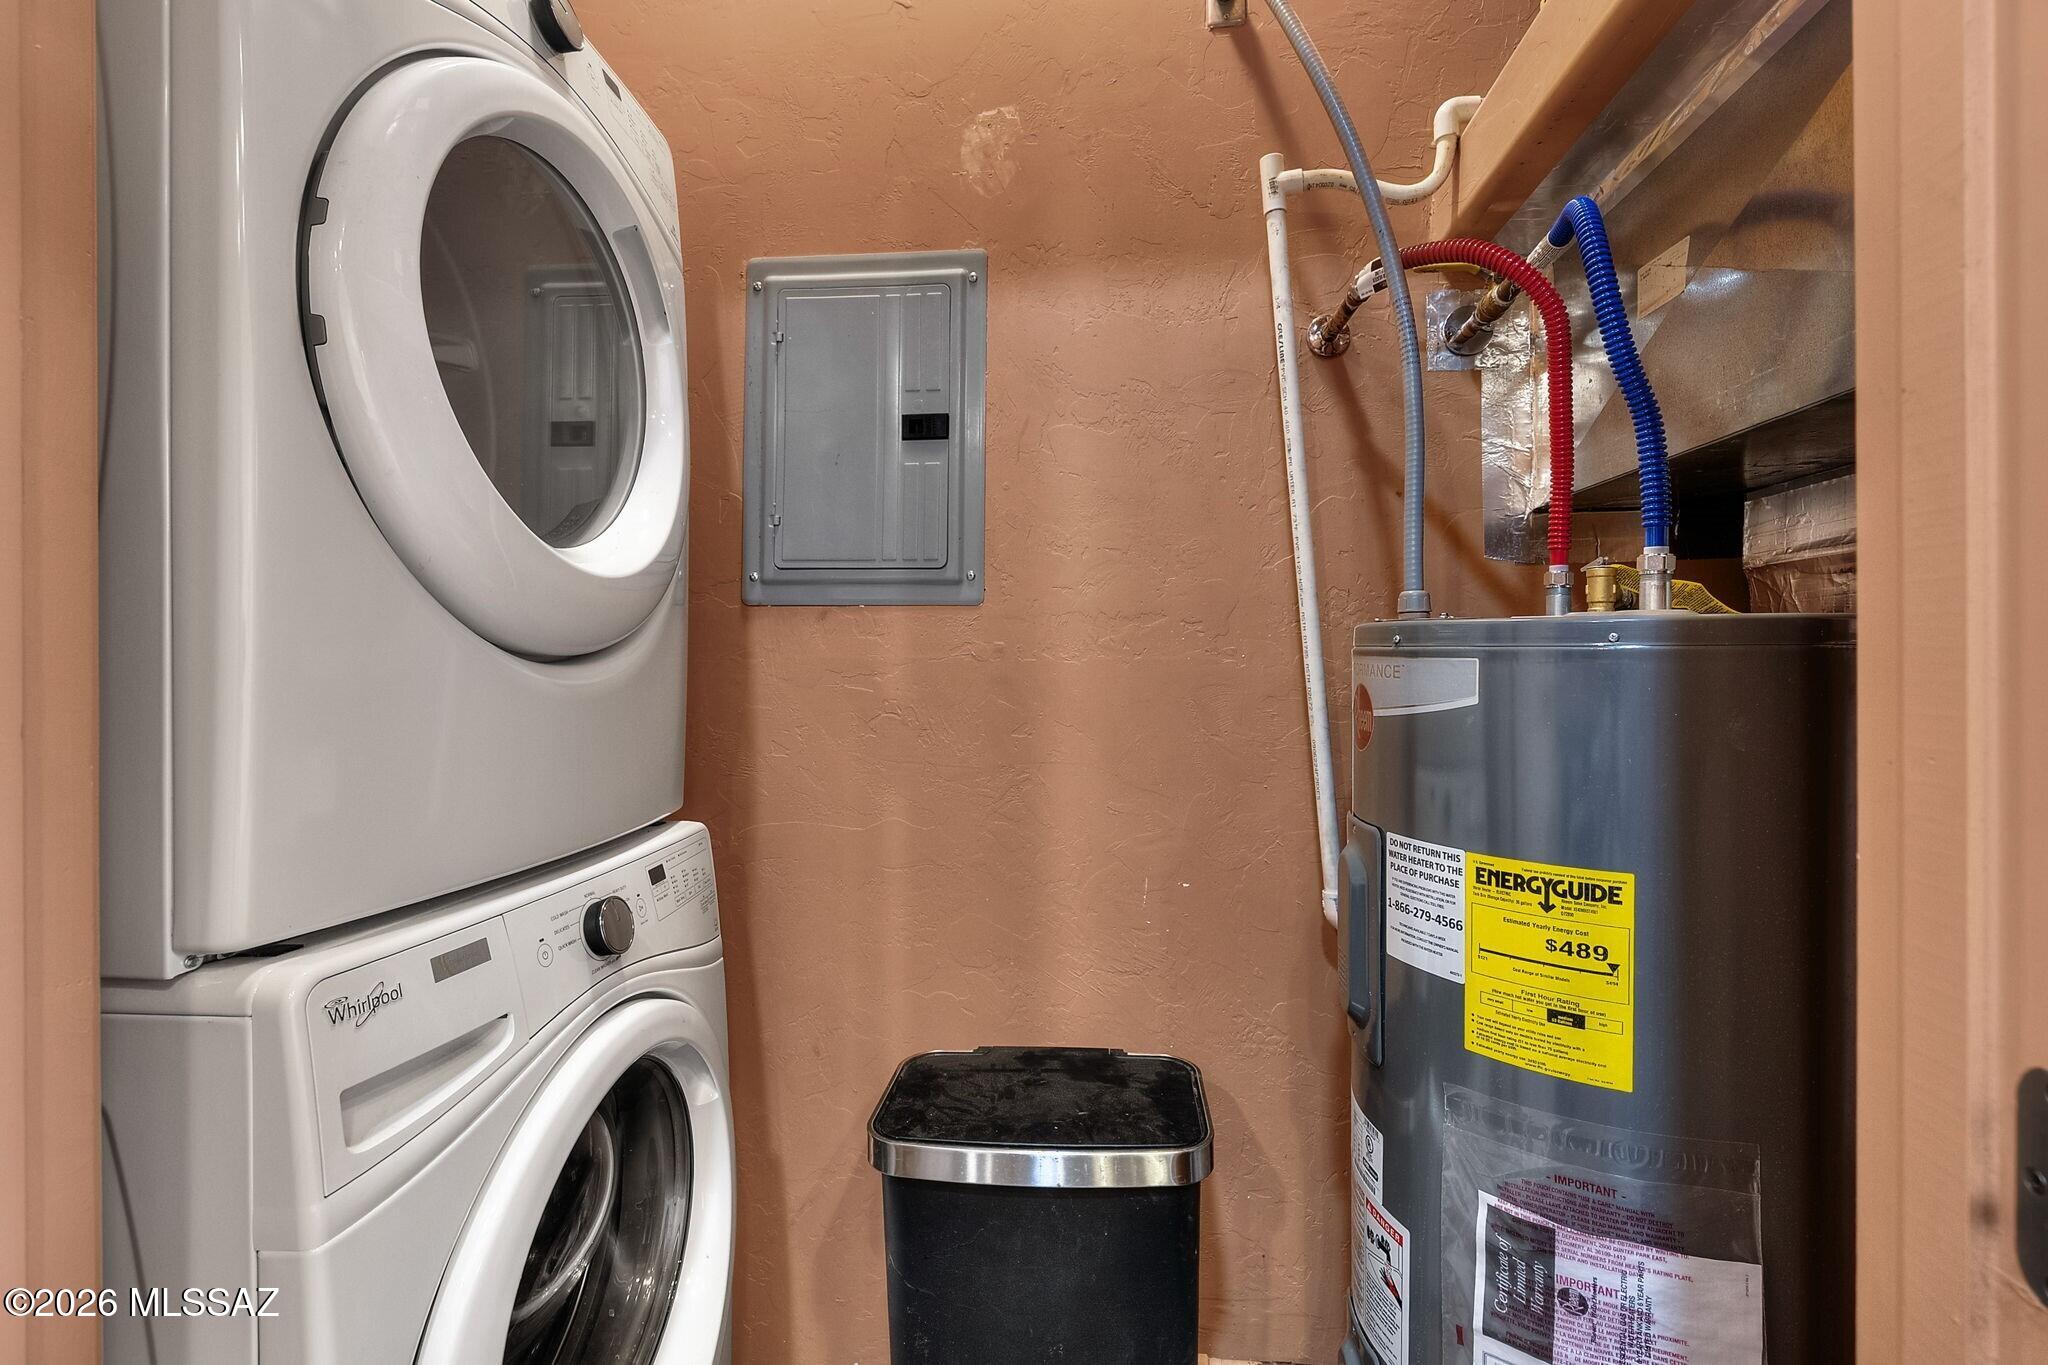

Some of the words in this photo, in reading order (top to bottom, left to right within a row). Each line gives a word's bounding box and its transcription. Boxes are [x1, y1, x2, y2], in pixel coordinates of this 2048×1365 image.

[1388, 849, 1407, 861] WATER
[1408, 855, 1434, 870] HEATER
[1435, 863, 1446, 872] TO
[1447, 865, 1463, 876] THE
[1389, 837, 1398, 847] DO
[1399, 841, 1412, 851] NOT
[1413, 844, 1440, 859] RETURN
[1442, 851, 1461, 863] THIS
[1390, 861, 1408, 875] PLACE
[1409, 868, 1418, 877] OF
[1419, 871, 1460, 888] PURCHASE
[1475, 866, 1623, 906] ENERGYGUIDE
[1387, 897, 1463, 931] 1-866-279-4566
[1503, 916, 1530, 927] Estimated
[1532, 922, 1551, 932] Yearly
[1552, 926, 1573, 935] Energy
[1545, 938, 1609, 962] $489
[328, 982, 404, 1025] Whirlpool
[1521, 989, 1536, 998] First
[1537, 993, 1554, 1002] Hour
[1556, 997, 1579, 1007] Rating
[1553, 1173, 1617, 1200] IMPORTANT
[1615, 1204, 1638, 1215] MANUAL
[1372, 1210, 1400, 1242] DANGER
[1495, 1232, 1512, 1252] of
[1560, 1245, 1579, 1256] SERIAL
[1580, 1250, 1606, 1263] NUMBERS
[1607, 1258, 1622, 1267] FROM
[1652, 1268, 1673, 1278] RATING
[1637, 1261, 1645, 1283] PARTS
[1494, 1251, 1512, 1314] Certificate
[1512, 1256, 1527, 1305] Limited
[1530, 1260, 1548, 1315] Warranty
[1620, 1270, 1628, 1302] ELECTRIC
[1636, 1284, 1645, 1302] YEAR
[1619, 1302, 1627, 1312] OR
[1619, 1312, 1627, 1326] GAS
[1628, 1295, 1636, 1324] HEATERS
[1636, 1307, 1644, 1322] AND
[1644, 1295, 1653, 1331] WARRANTY
[1627, 1325, 1635, 1349] WATER
[1636, 1322, 1644, 1339] TANK
